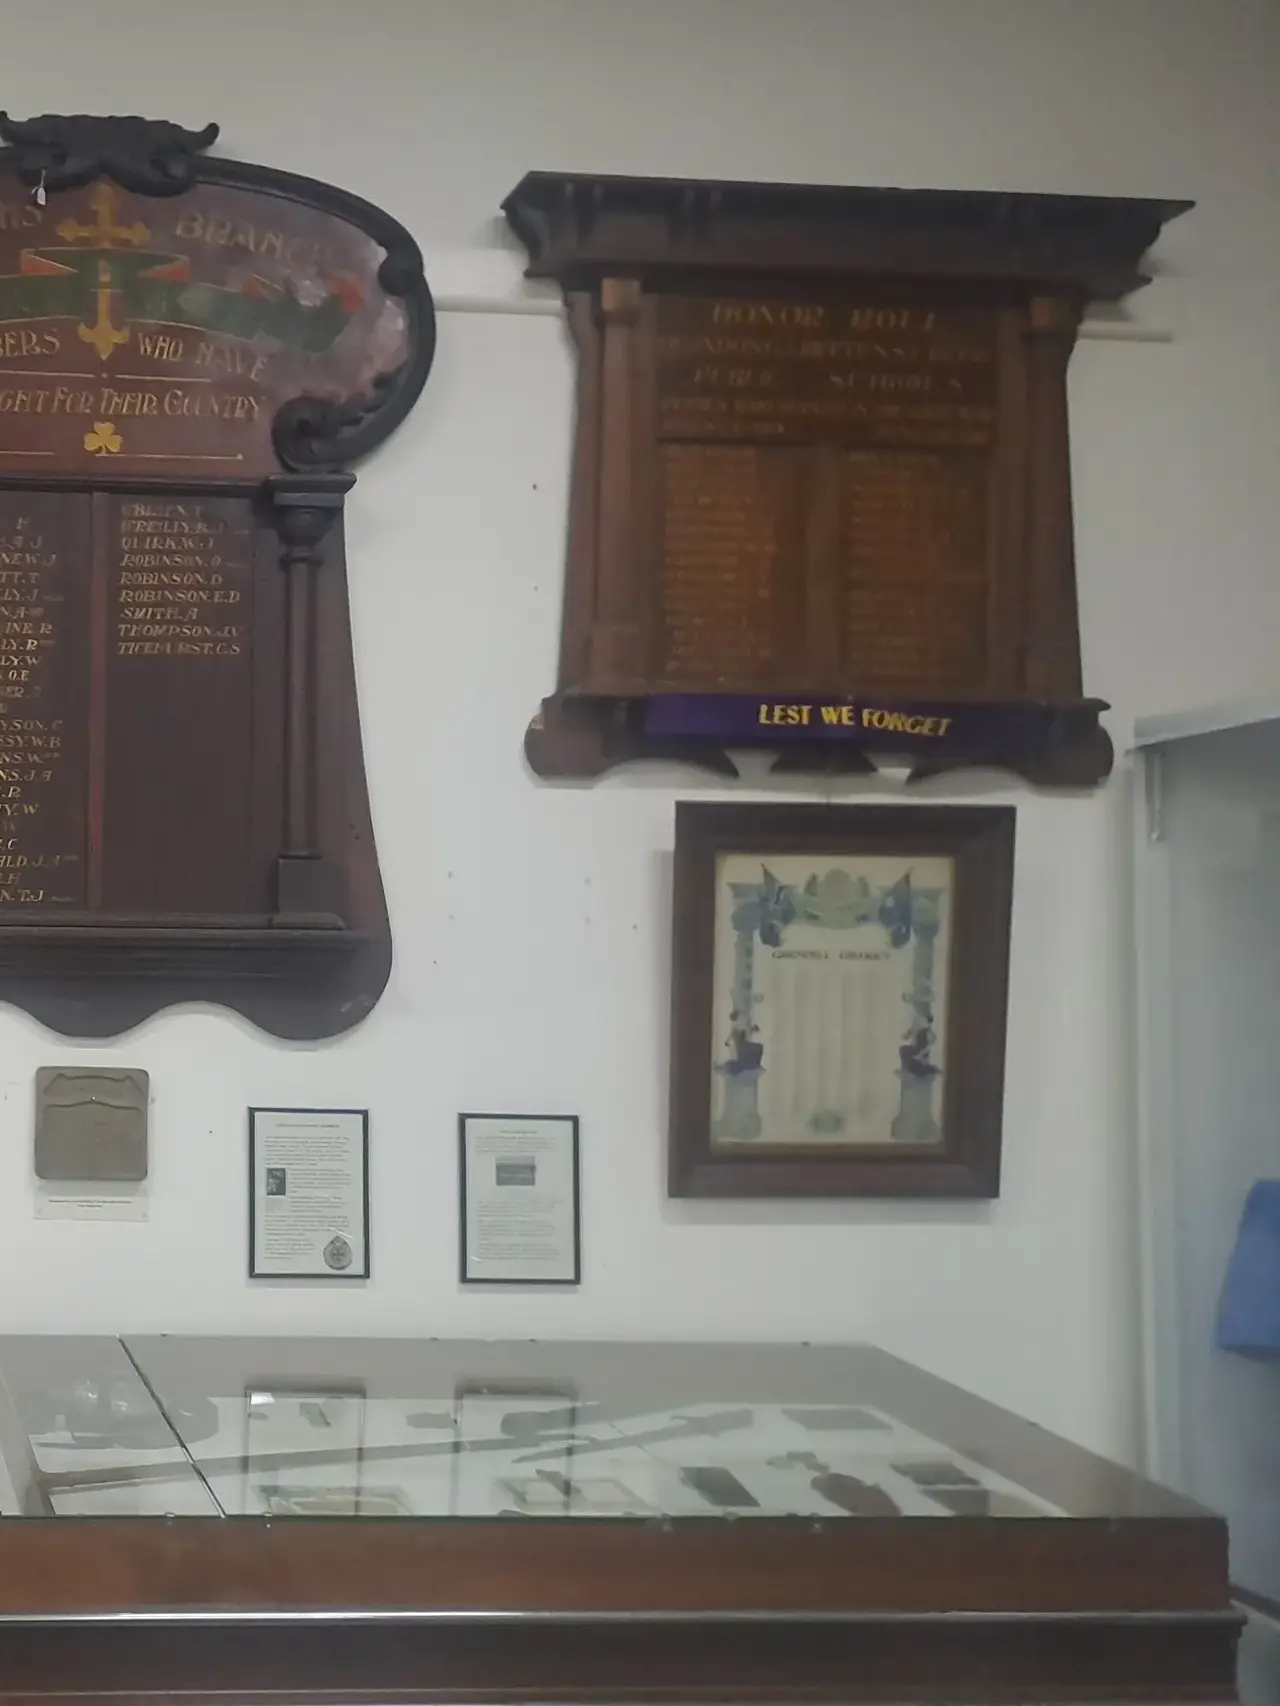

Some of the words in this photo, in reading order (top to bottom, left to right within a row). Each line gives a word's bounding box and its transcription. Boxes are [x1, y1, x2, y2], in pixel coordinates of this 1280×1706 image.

[137, 332, 183, 361] WHO
[52, 386, 94, 414] FOR
[100, 387, 159, 416] THEIR
[164, 389, 267, 422] COUNTRY
[758, 704, 812, 725] LEST
[820, 705, 855, 726] WE
[862, 708, 951, 737] FORGET
